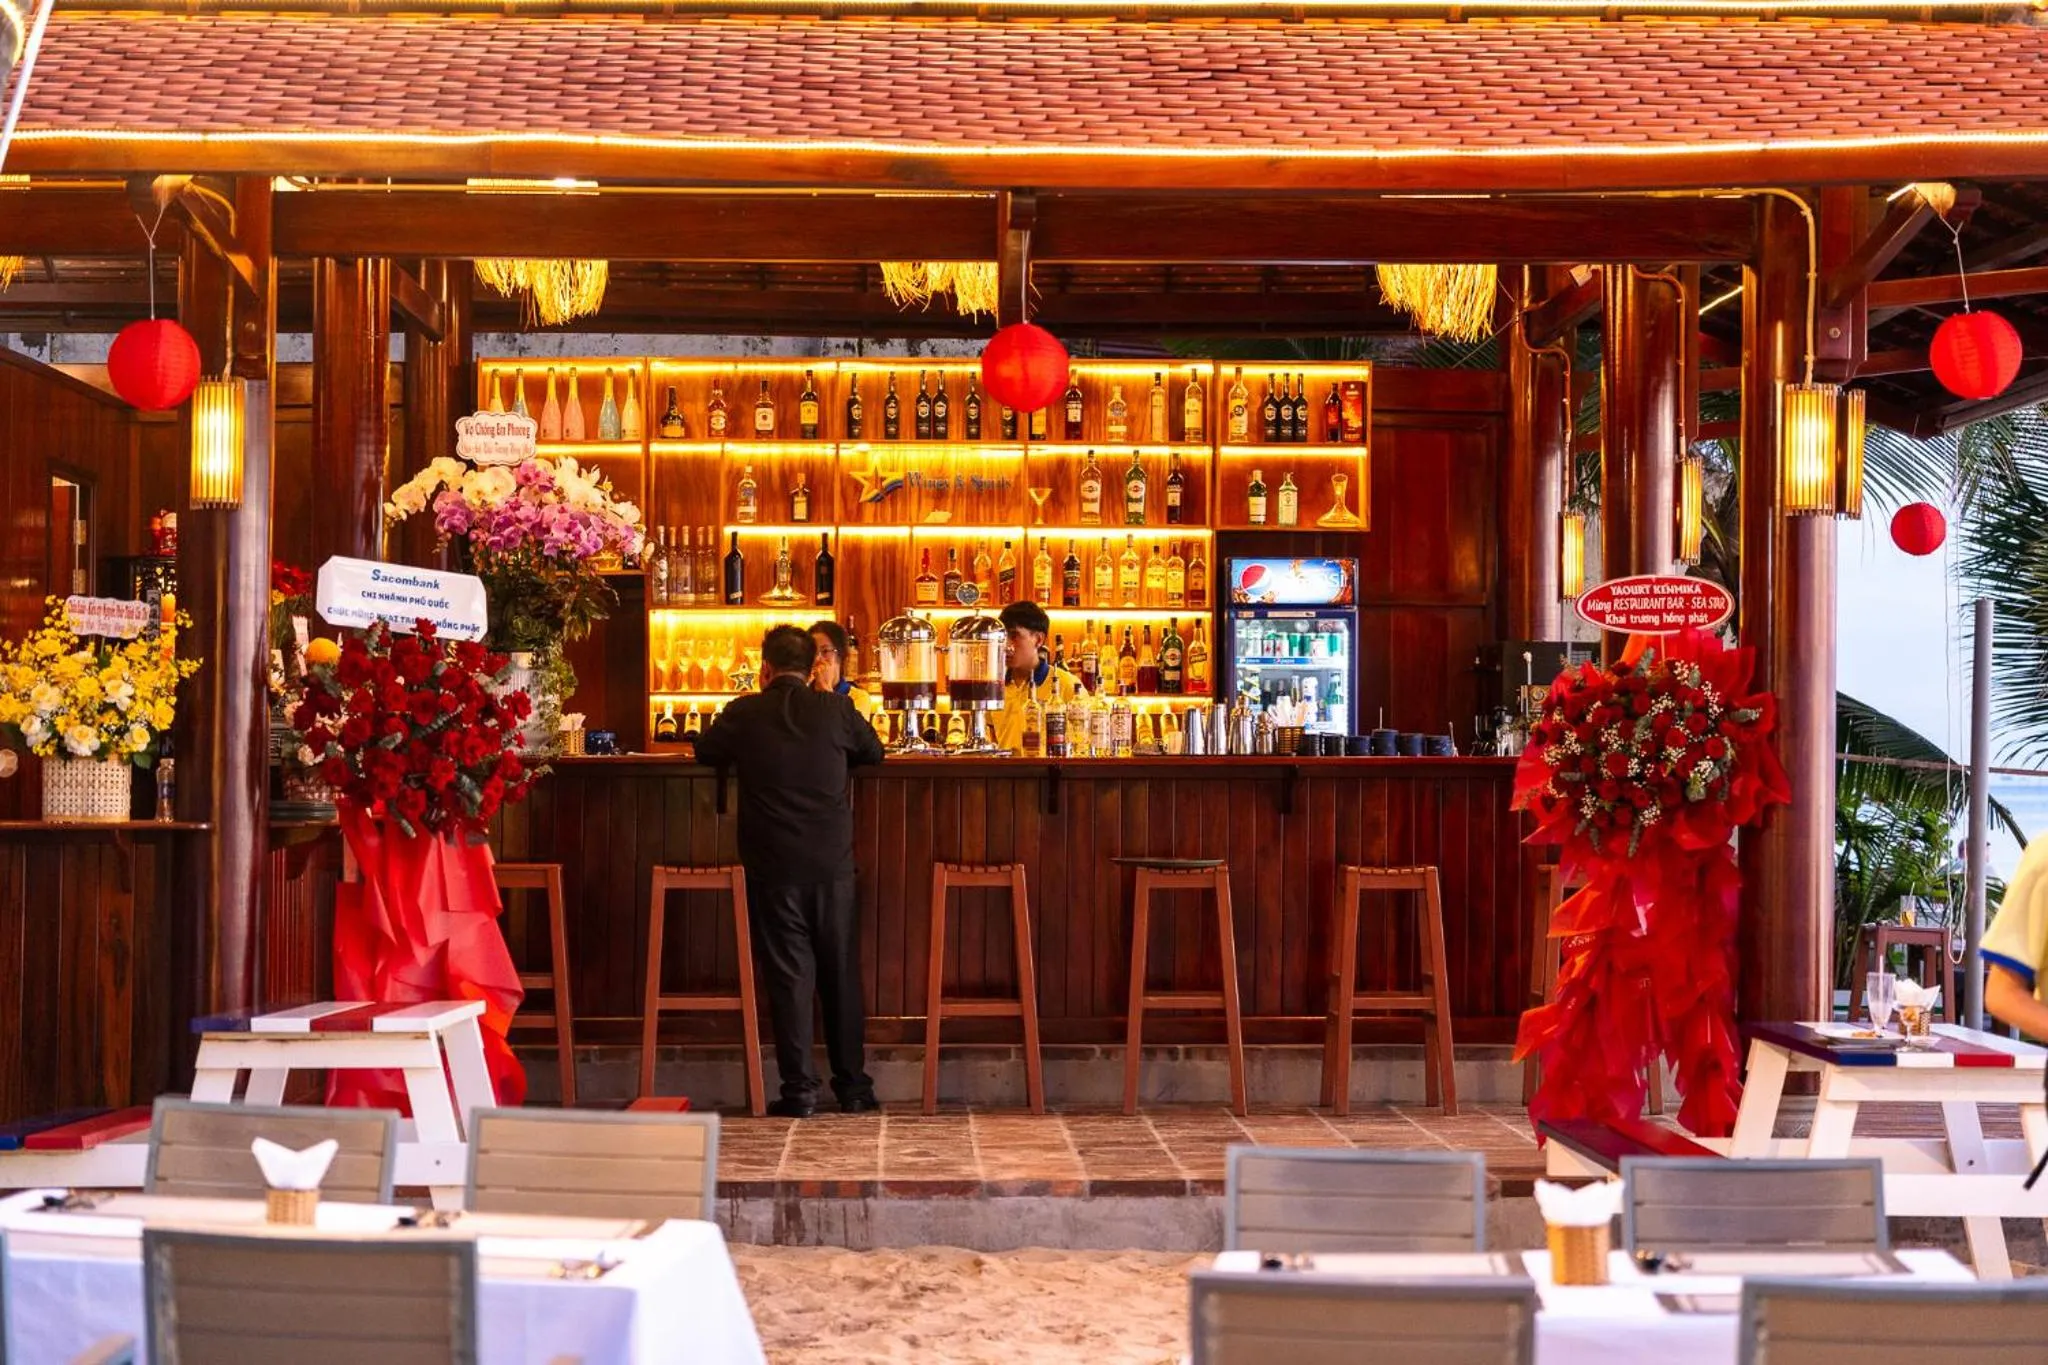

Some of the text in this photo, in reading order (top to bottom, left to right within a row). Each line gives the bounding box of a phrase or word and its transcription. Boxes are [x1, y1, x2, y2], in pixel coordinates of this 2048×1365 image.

[371, 568, 441, 590] Sacombank
[361, 590, 377, 599] CHI
[1610, 584, 1652, 596] YAOURT
[1613, 597, 1666, 611] RESTAURANT
[1666, 596, 1685, 609] BAR
[1691, 596, 1708, 609] SEA
[1708, 596, 1726, 609] STAR
[1605, 613, 1627, 625] Khai
